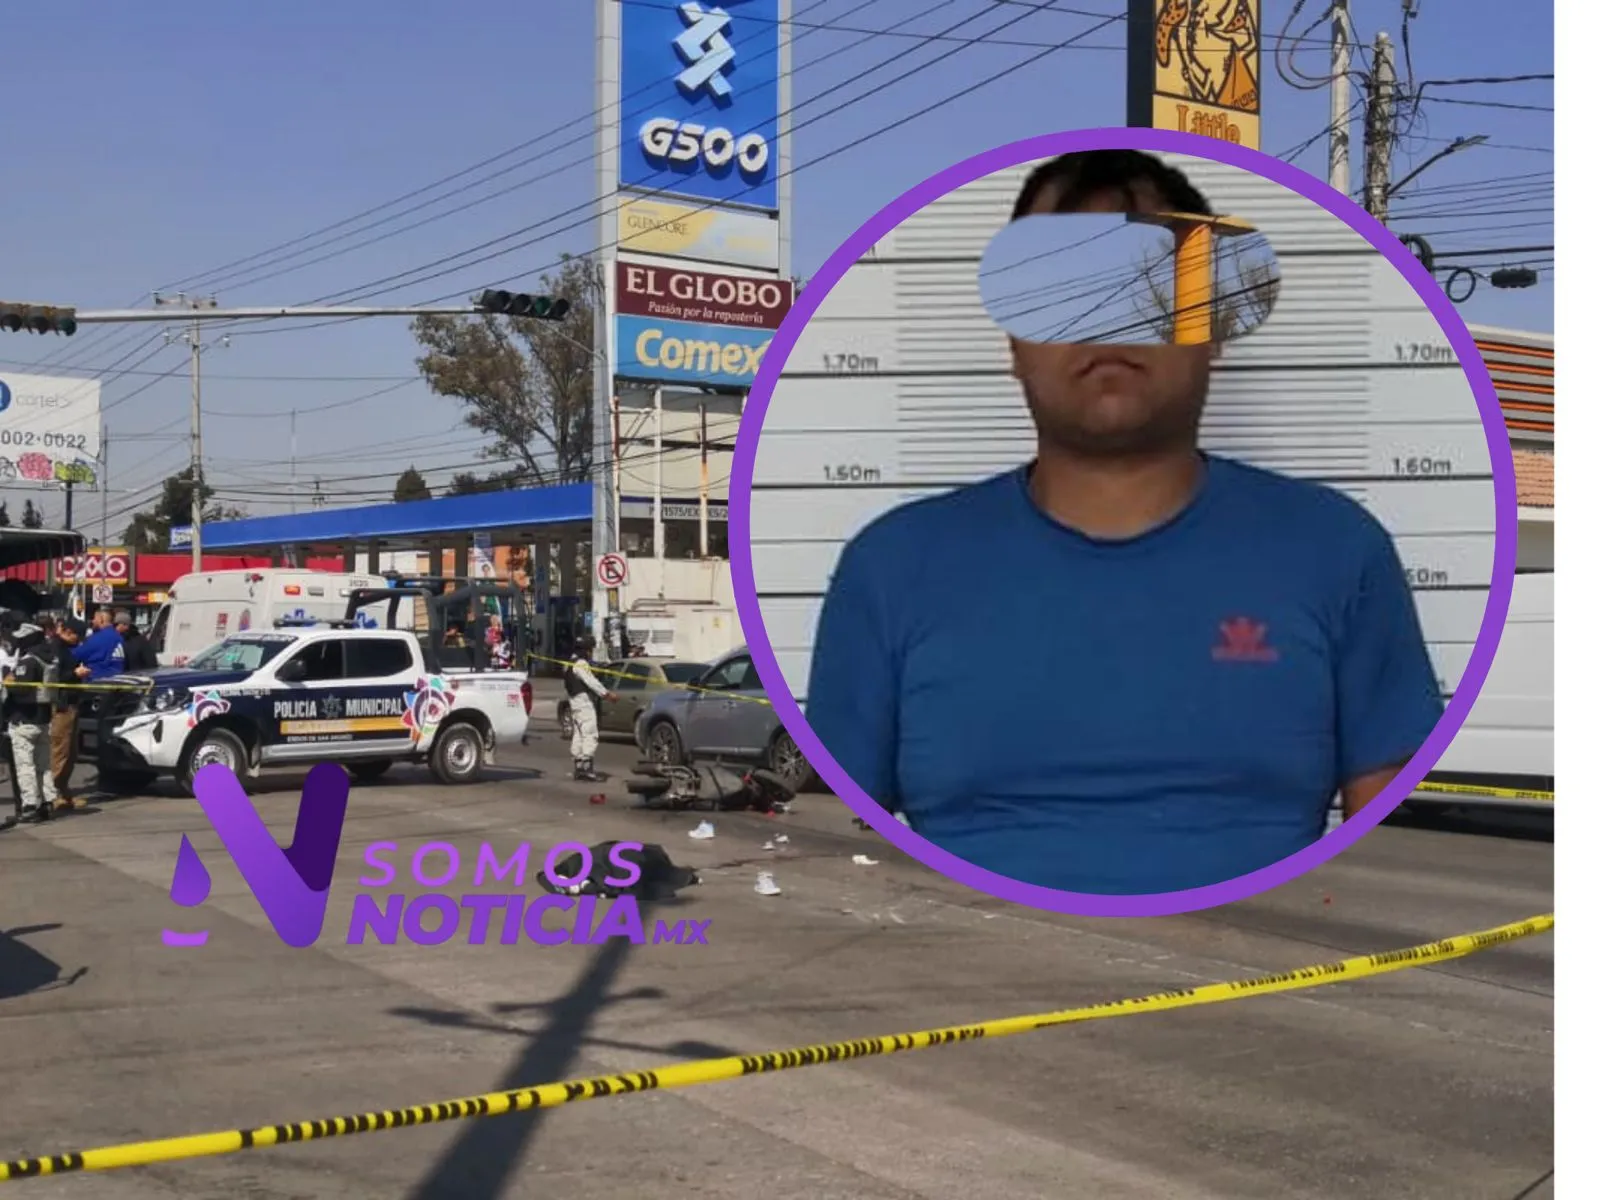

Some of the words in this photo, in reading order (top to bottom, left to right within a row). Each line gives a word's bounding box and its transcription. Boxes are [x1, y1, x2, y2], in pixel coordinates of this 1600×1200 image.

[639, 117, 768, 173] G500
[626, 214, 688, 236] GLENCORE
[626, 267, 664, 296] EL
[669, 273, 782, 309] GLOBO
[648, 301, 682, 315] Pasión
[682, 308, 701, 321] por
[702, 307, 713, 318] la
[636, 328, 773, 376] Comex
[822, 354, 879, 370] 1.70m
[1393, 457, 1451, 473] 1.60m
[345, 697, 403, 717] MUNICIPAL
